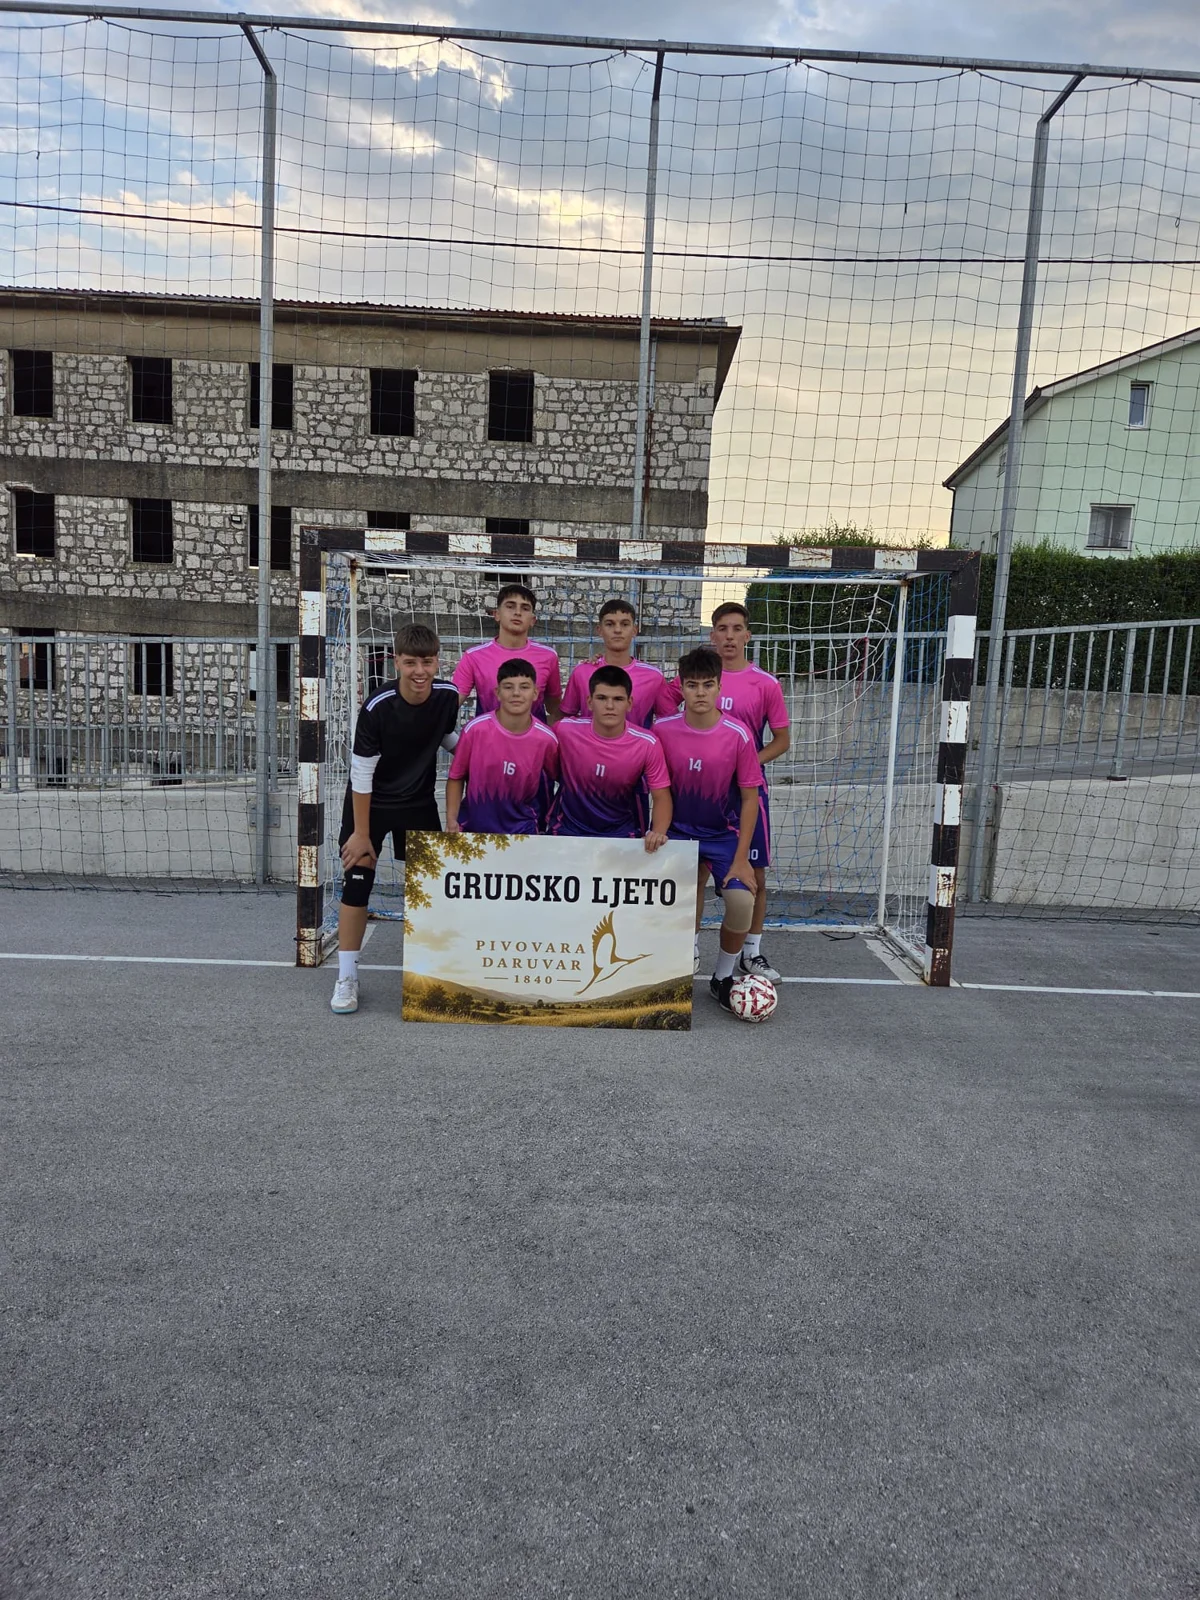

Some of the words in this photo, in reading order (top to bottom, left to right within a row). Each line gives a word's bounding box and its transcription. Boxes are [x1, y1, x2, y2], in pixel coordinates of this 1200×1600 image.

[720, 696, 733, 710] 10
[503, 760, 516, 776] 16
[595, 763, 606, 777] 11
[688, 757, 702, 772] 14
[444, 872, 580, 903] GRUDSKO
[591, 876, 677, 908] LJETO
[476, 940, 586, 954] PIVOVARA
[482, 957, 581, 971] DARUVAR
[514, 975, 553, 985] 1840
